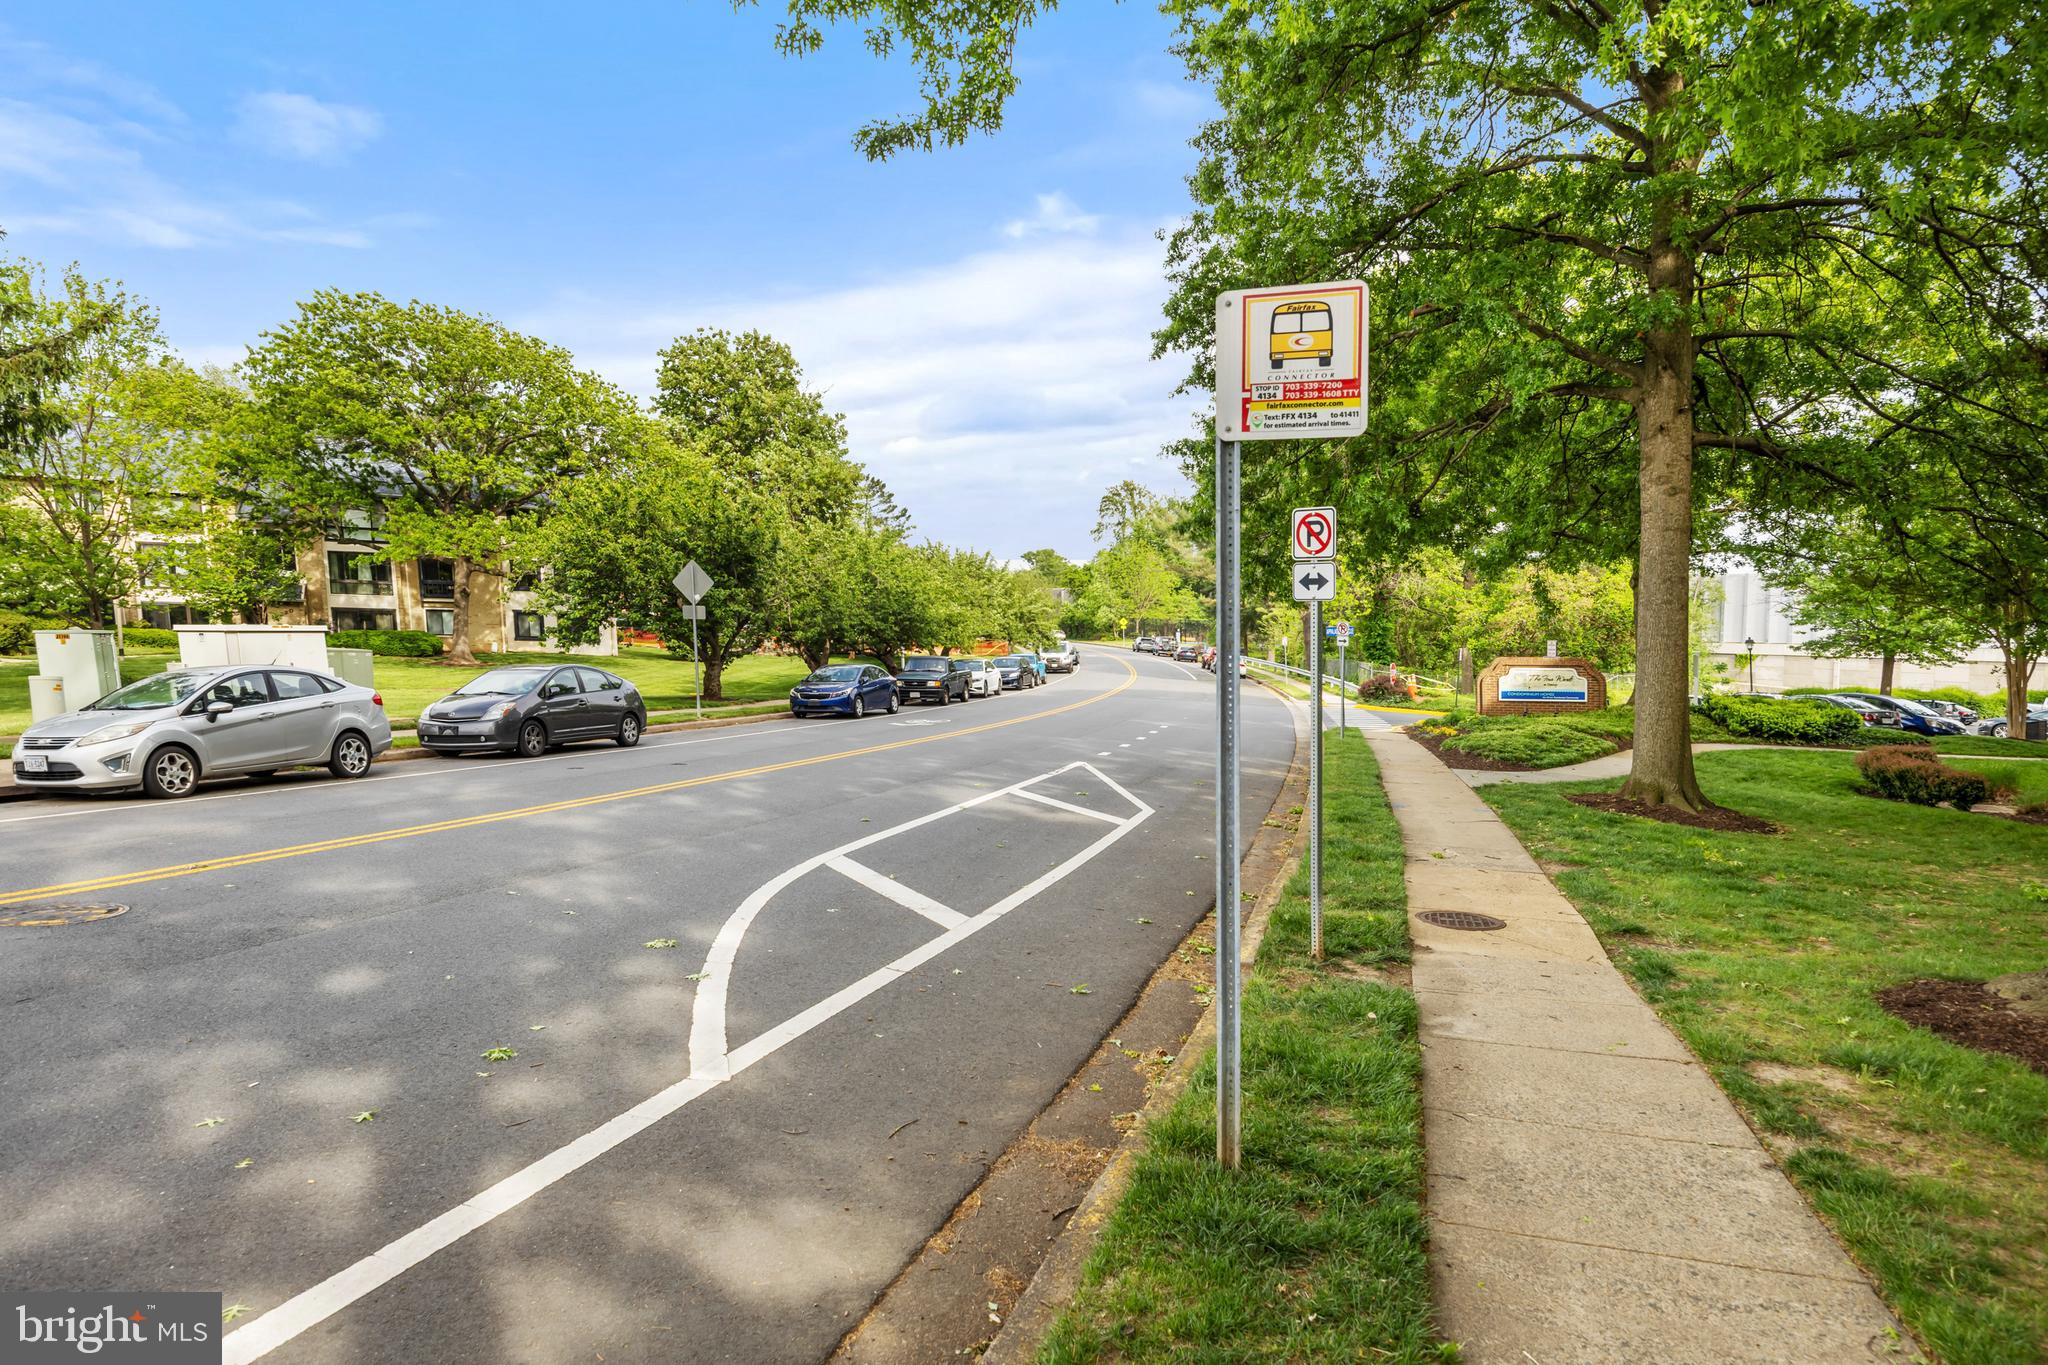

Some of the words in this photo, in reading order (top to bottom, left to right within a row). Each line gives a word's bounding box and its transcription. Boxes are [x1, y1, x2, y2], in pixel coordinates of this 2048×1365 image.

[1287, 304, 1316, 312] Fairfax
[1267, 372, 1336, 382] CONNECTOR
[1285, 381, 1343, 390] 703-339-7200
[1257, 392, 1277, 400] 4134
[1285, 390, 1342, 399] 703-339-1608
[1342, 389, 1360, 397] TTY
[1266, 400, 1344, 409] fairfaxconnector.com
[1308, 420, 1330, 428] arrival
